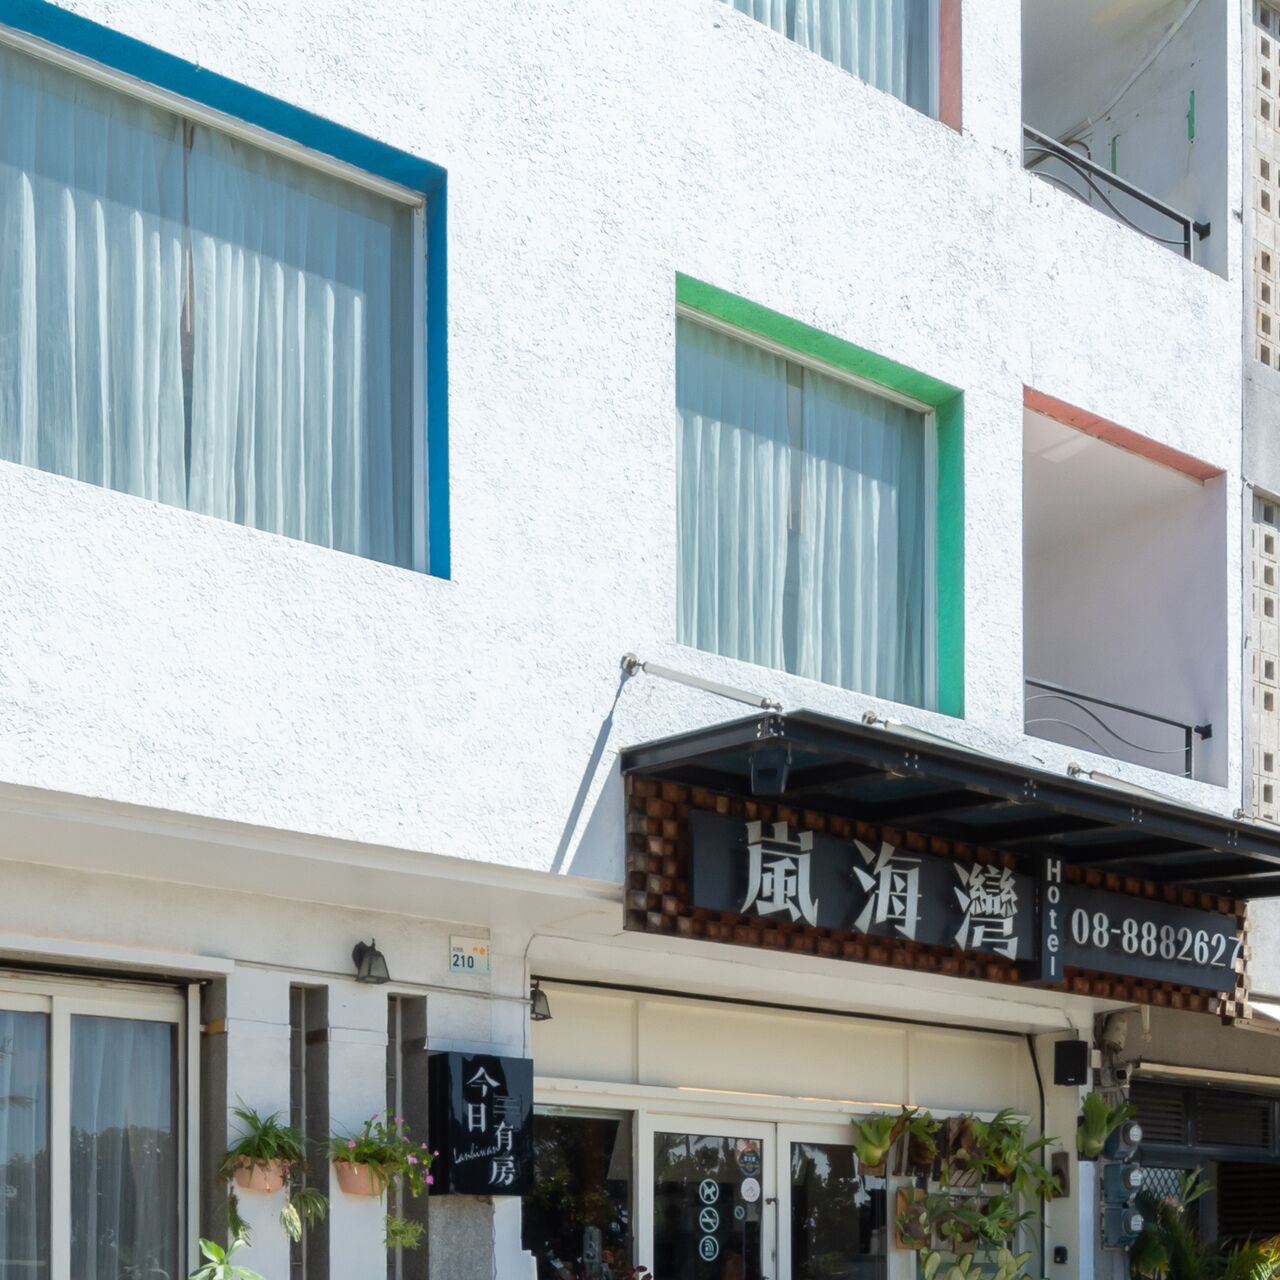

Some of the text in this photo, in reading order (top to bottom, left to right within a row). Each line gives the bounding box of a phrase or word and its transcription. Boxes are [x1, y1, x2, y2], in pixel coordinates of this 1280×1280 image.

[740, 820, 1019, 961] 嵐海灣
[1046, 858, 1061, 977] Hotel
[452, 953, 474, 969] 210
[1071, 907, 1243, 970] 08-8882627
[466, 1066, 500, 1133] 今日
[488, 1121, 516, 1186] 有房
